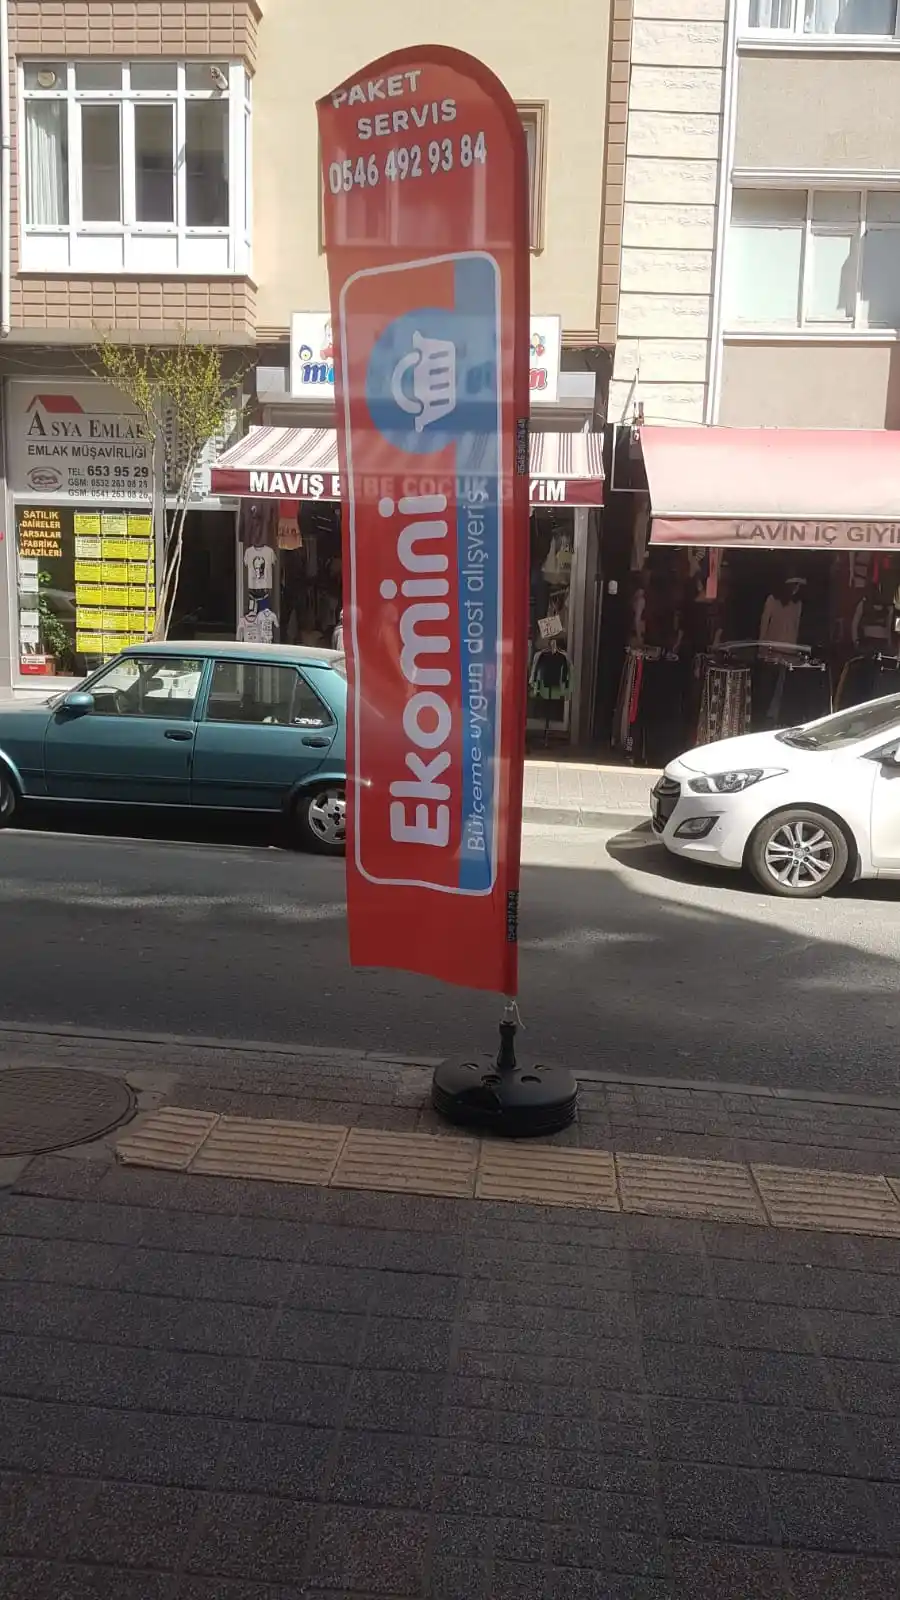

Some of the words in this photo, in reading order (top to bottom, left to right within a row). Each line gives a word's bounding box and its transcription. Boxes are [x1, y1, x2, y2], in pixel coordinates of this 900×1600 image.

[331, 69, 421, 108] PAKET
[357, 98, 457, 140] SERVIS
[329, 153, 379, 194] 0546
[384, 144, 422, 182] 492
[428, 137, 453, 174] 93
[460, 131, 487, 168] 84
[27, 409, 83, 438] ASYA
[88, 419, 146, 439] EMLAK
[27, 444, 69, 457] EMLAK
[71, 444, 147, 460] MÜŞAVİRLİĞİ
[87, 465, 110, 477] 653
[114, 466, 130, 478] 95
[133, 466, 149, 478] 29
[23, 510, 60, 519] SATILIK
[461, 487, 490, 593] alışveriş
[463, 598, 485, 655] dost
[378, 493, 452, 848] Ekomini
[467, 662, 489, 740] uygun
[466, 747, 486, 851] Bütçeme
